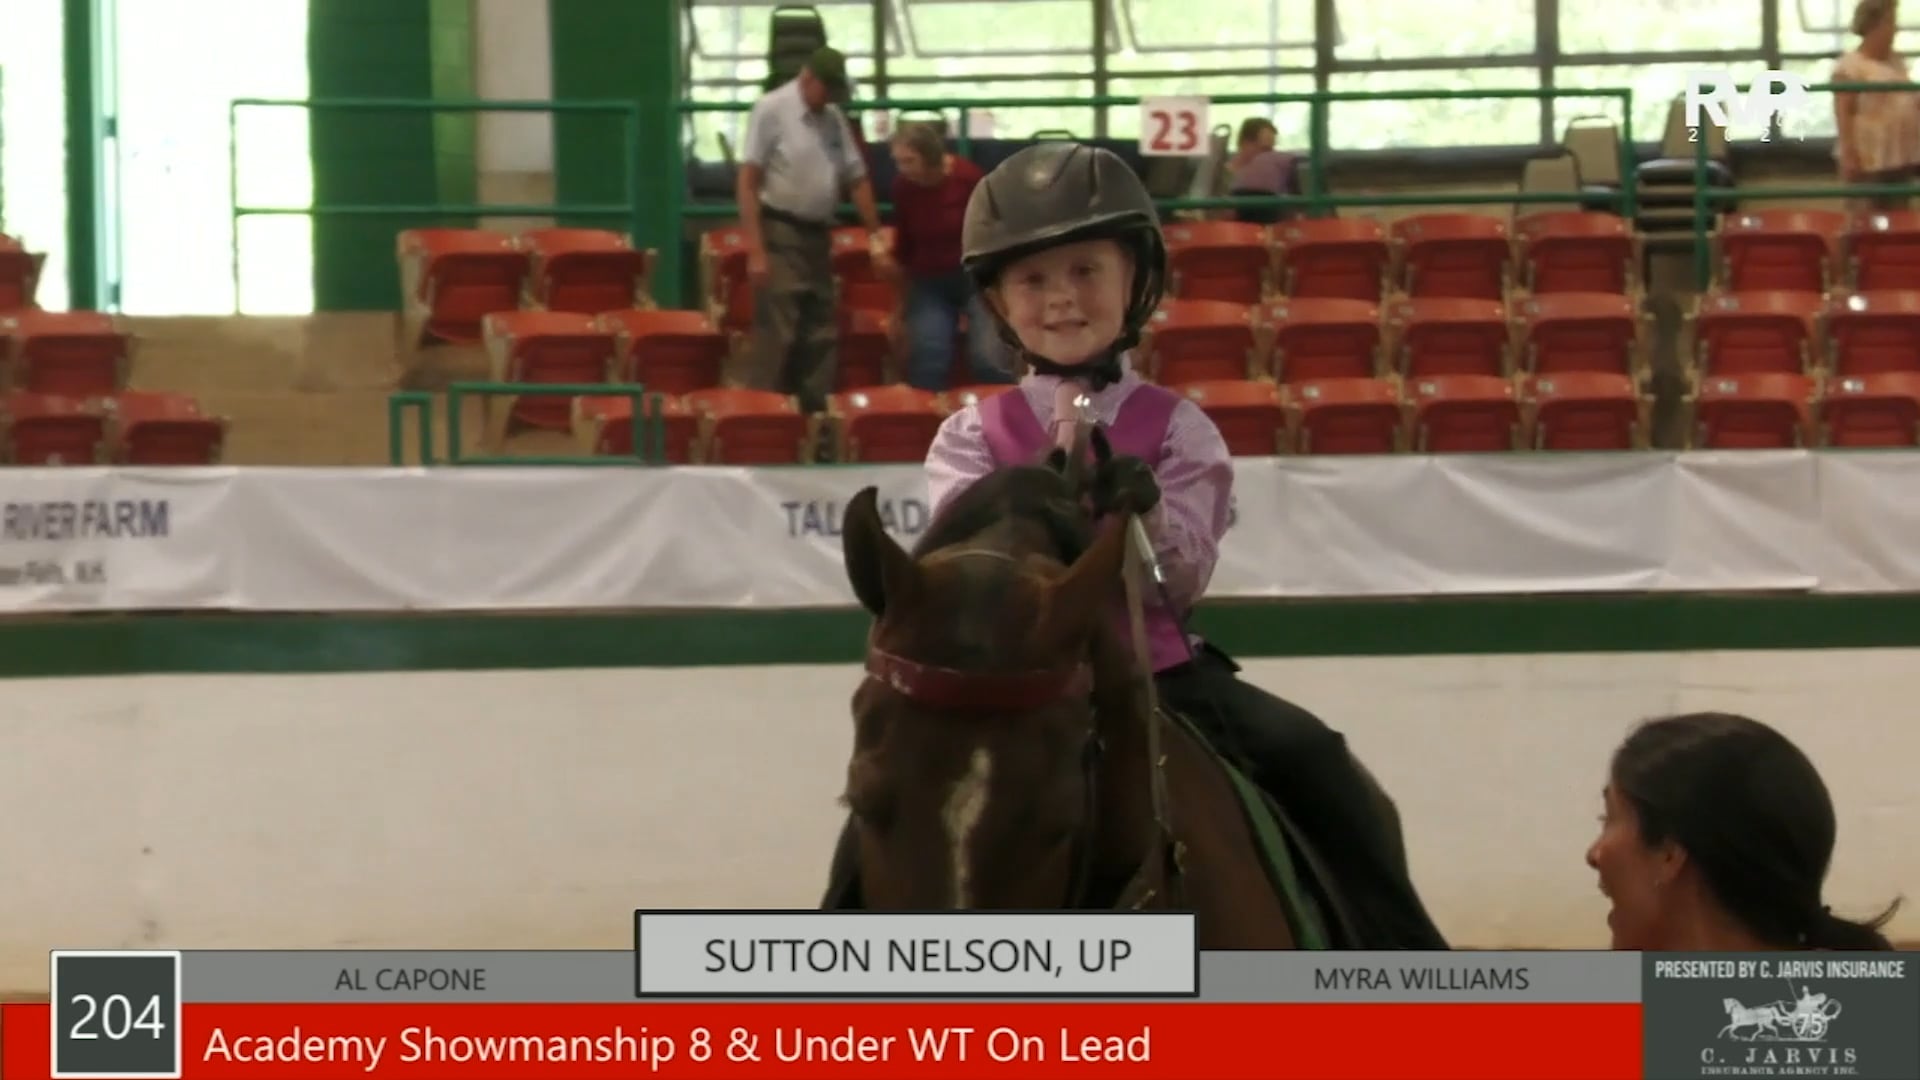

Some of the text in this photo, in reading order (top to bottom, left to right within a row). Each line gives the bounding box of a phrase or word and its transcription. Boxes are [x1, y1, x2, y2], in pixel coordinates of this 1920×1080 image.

[1150, 110, 1198, 150] 23
[3, 499, 169, 541] RIVER FARM
